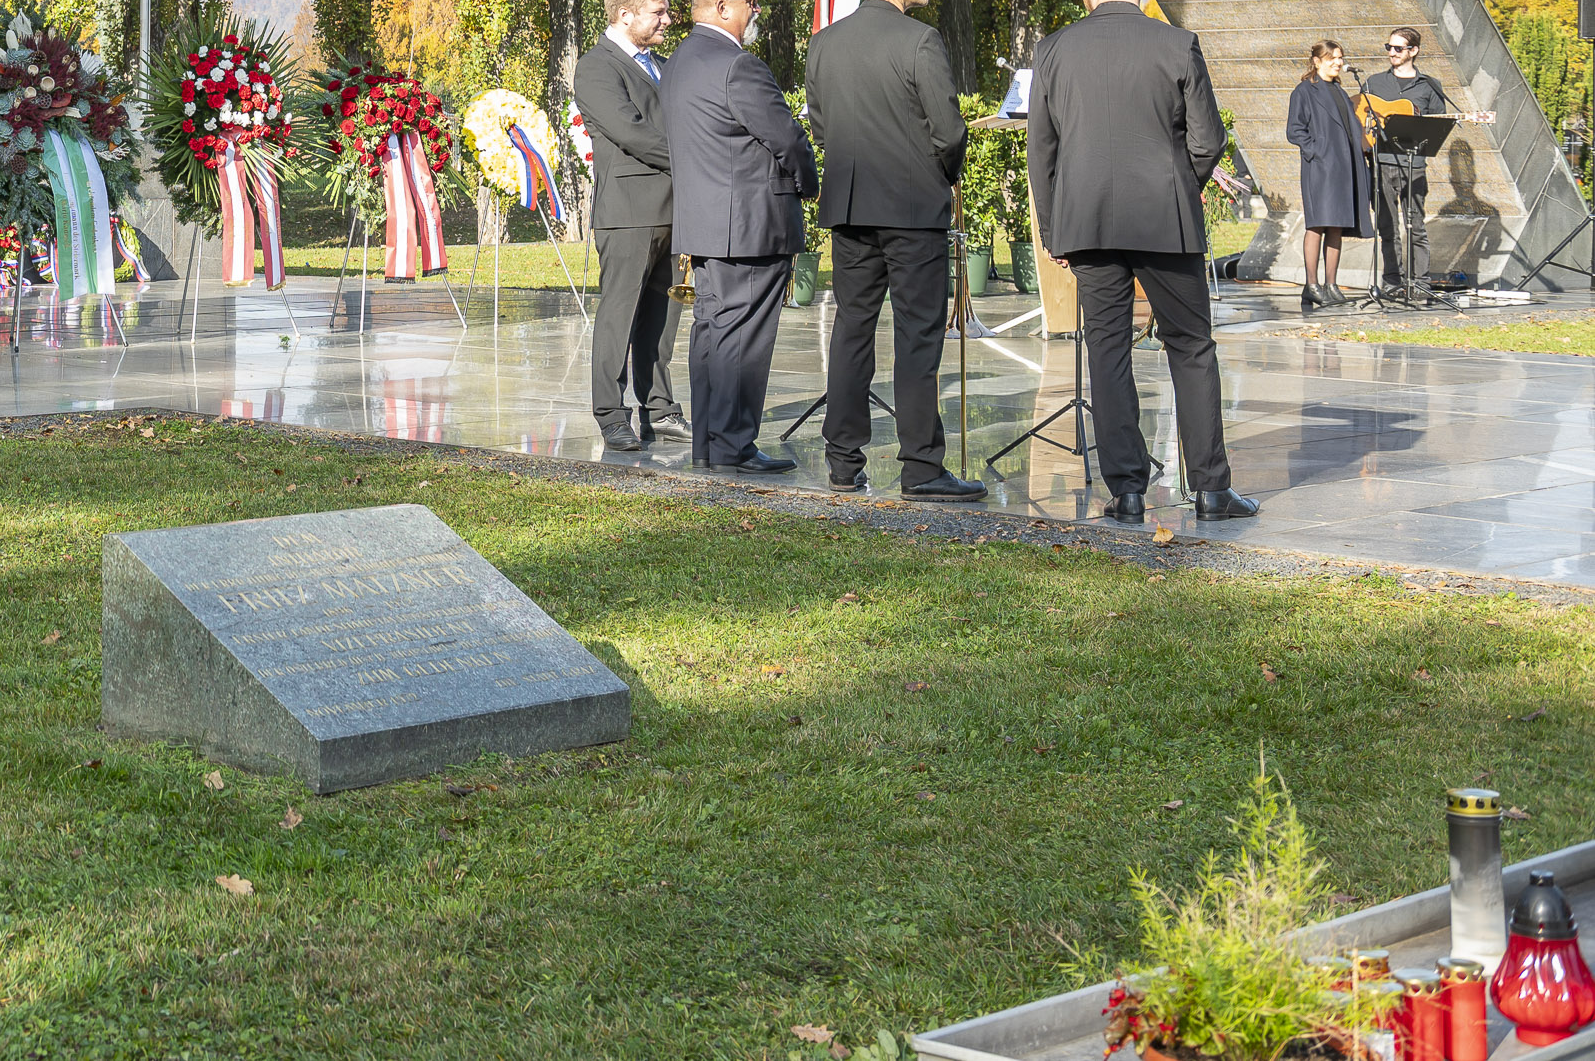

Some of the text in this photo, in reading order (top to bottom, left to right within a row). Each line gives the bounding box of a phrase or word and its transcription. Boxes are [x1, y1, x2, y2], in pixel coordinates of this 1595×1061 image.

[218, 565, 475, 613] FRITZ MATZNER
[358, 650, 512, 686] ZUM GEDENKEN
